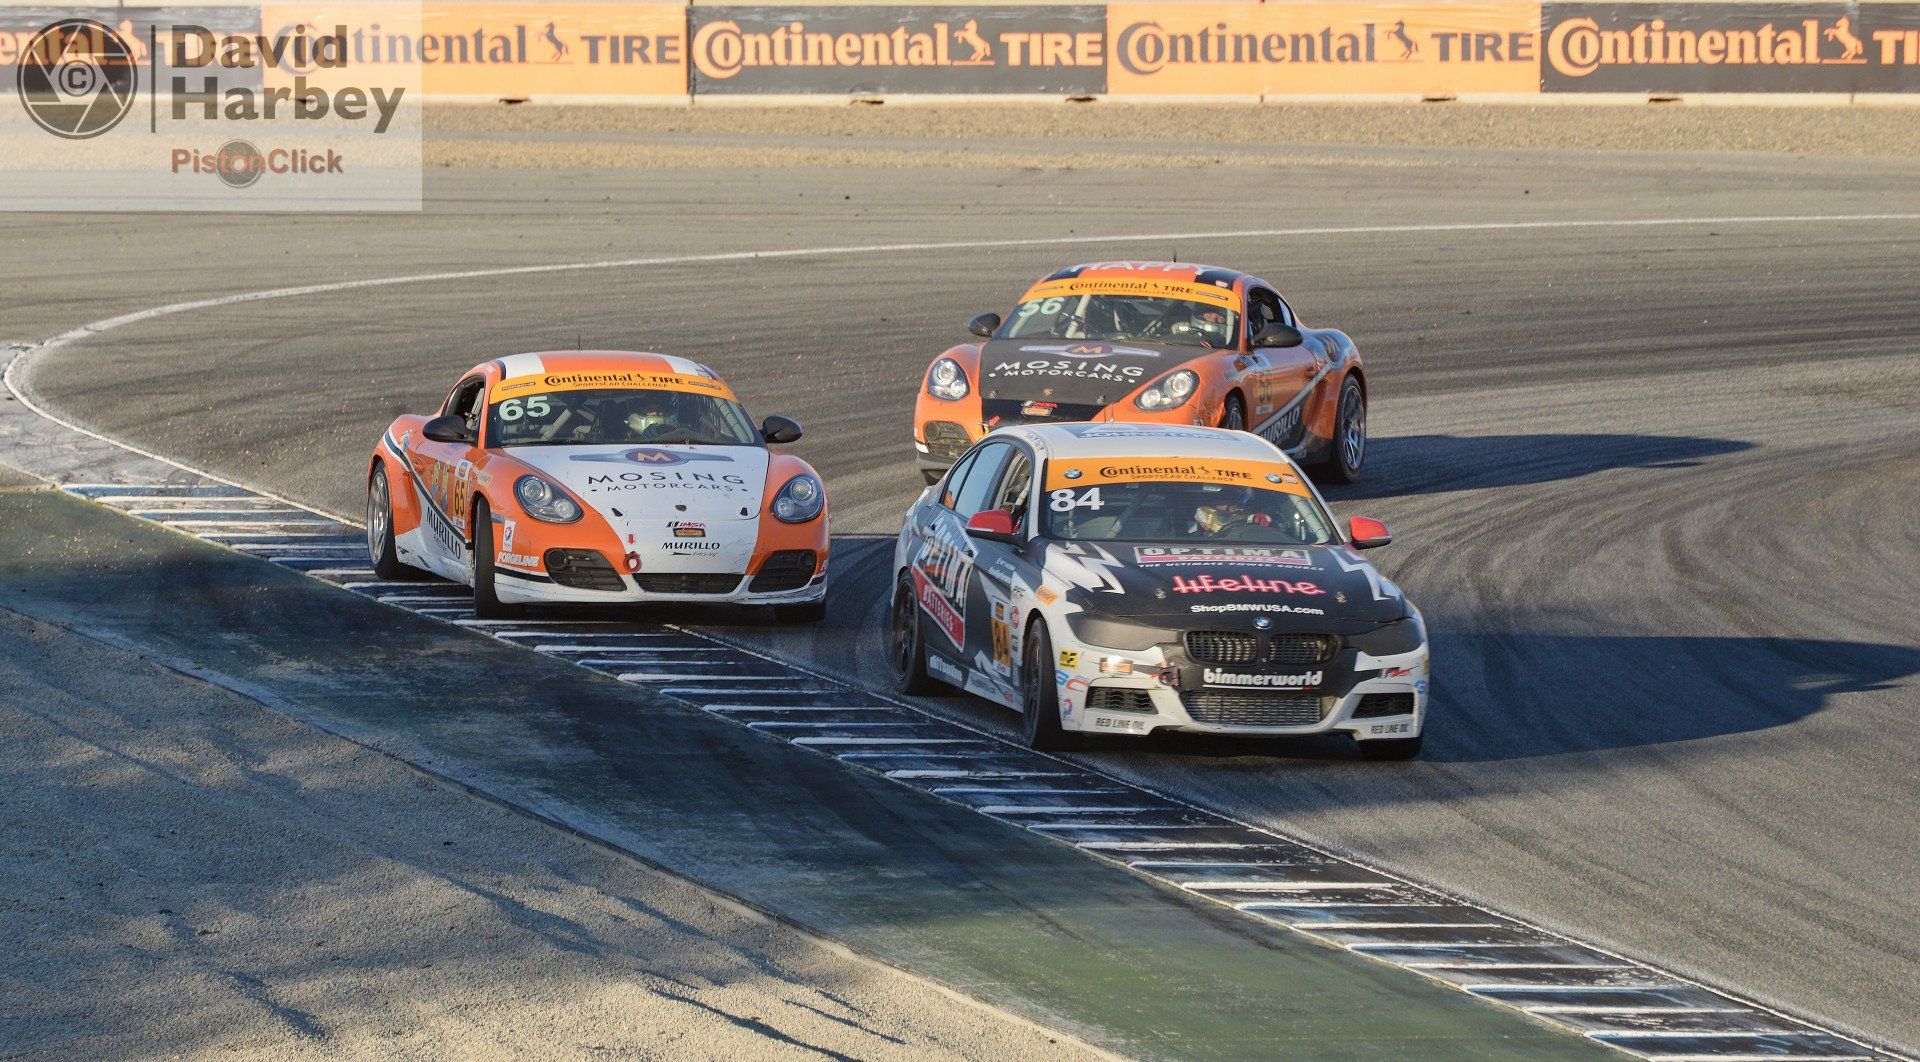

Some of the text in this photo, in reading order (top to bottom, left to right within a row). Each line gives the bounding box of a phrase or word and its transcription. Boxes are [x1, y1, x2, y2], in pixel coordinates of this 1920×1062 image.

[276, 22, 680, 76] Continental TIRE
[693, 20, 1102, 78] Continental TIRE
[1117, 20, 1534, 76] Continental TIRE
[1547, 17, 1822, 77] Continental
[1069, 281, 1148, 291] Continental
[1164, 285, 1195, 295] TIRE
[1018, 297, 1066, 318] 56
[994, 360, 1145, 377] MOSING
[1003, 369, 1124, 382] MOTORCARS
[544, 373, 632, 386] Continental
[650, 376, 685, 385] TIRE
[498, 395, 551, 422] 65
[588, 472, 745, 485] MOSING
[1099, 465, 1253, 479] Continental TIRE
[607, 482, 734, 492] MOTORCARS
[1050, 487, 1104, 512] 84
[427, 505, 461, 560] MURILLO
[661, 541, 720, 550] MURILLO
[1143, 548, 1301, 558] OPTIMA
[1171, 574, 1327, 595] lifeline
[1190, 603, 1325, 616] ShopBMWUSA.com
[1203, 668, 1323, 686] bimmerworld
